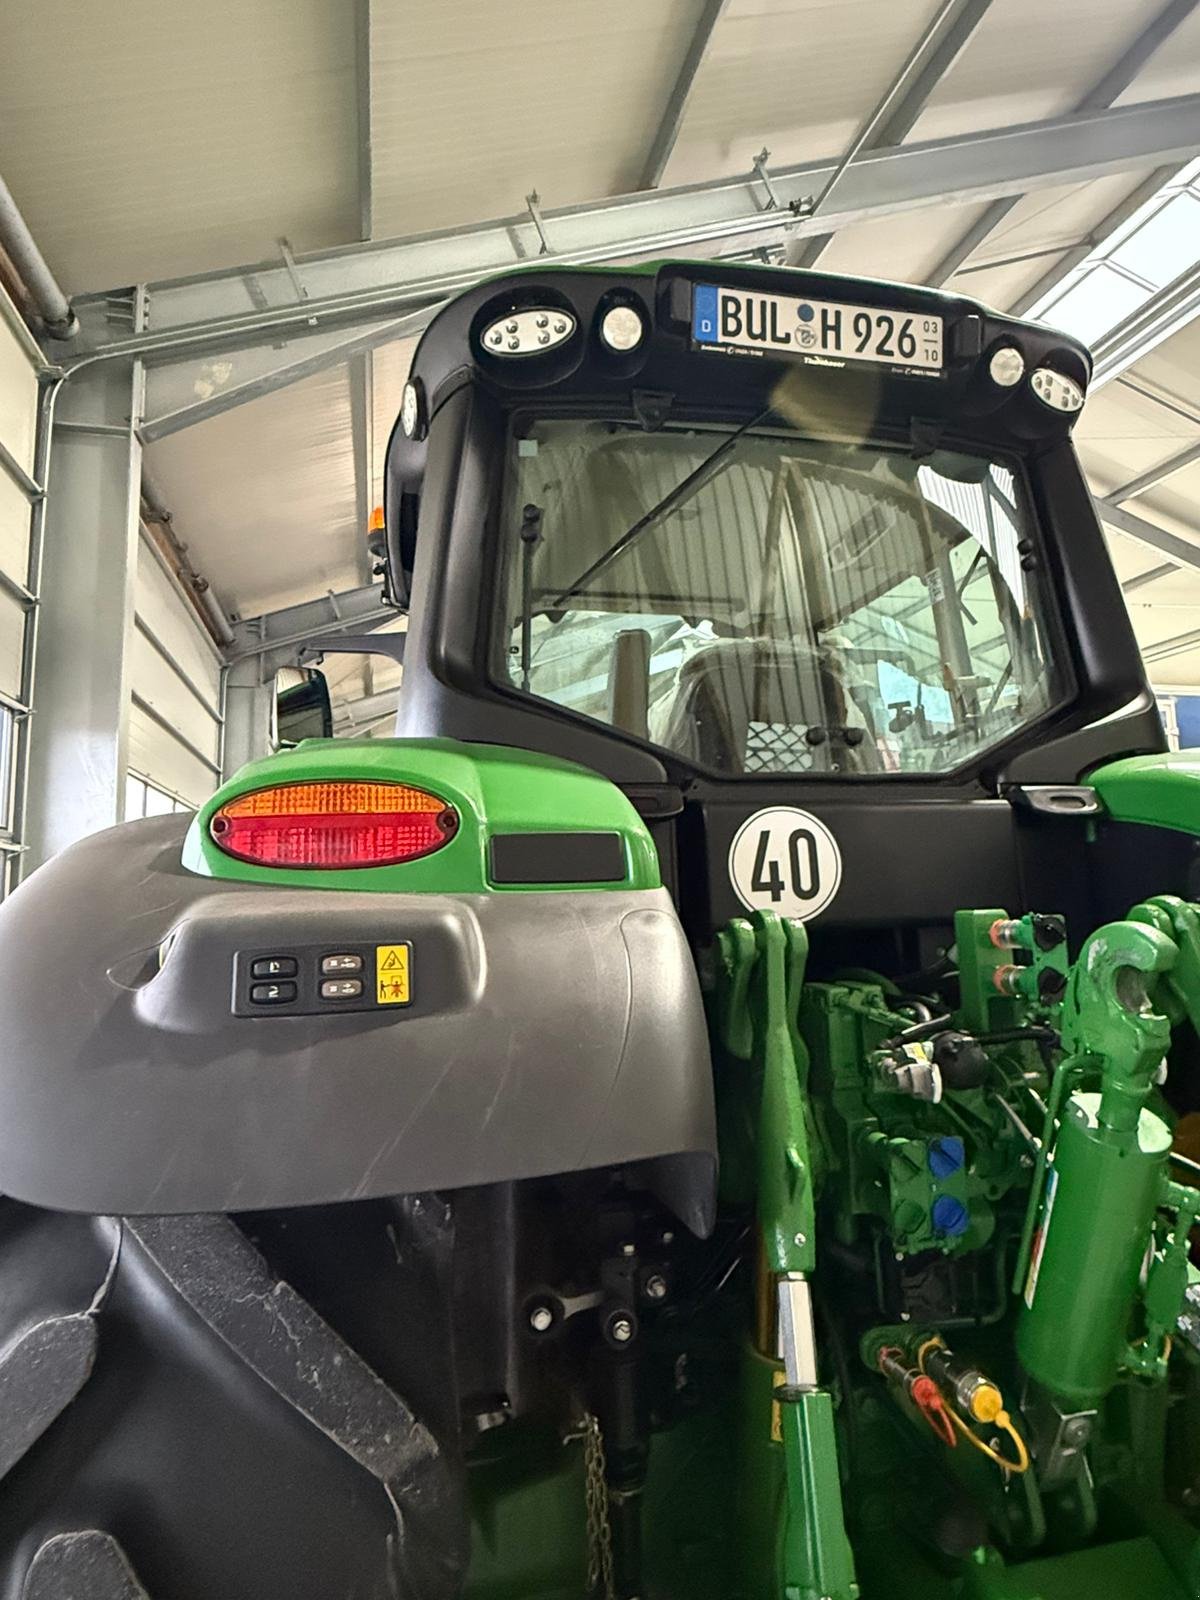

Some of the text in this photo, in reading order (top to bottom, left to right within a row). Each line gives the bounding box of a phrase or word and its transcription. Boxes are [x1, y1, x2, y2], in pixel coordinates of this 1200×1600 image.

[701, 319, 711, 333] D
[721, 295, 916, 359] BUL H 926
[923, 320, 938, 334] 03
[924, 349, 938, 362] 10
[751, 828, 820, 902] 40
